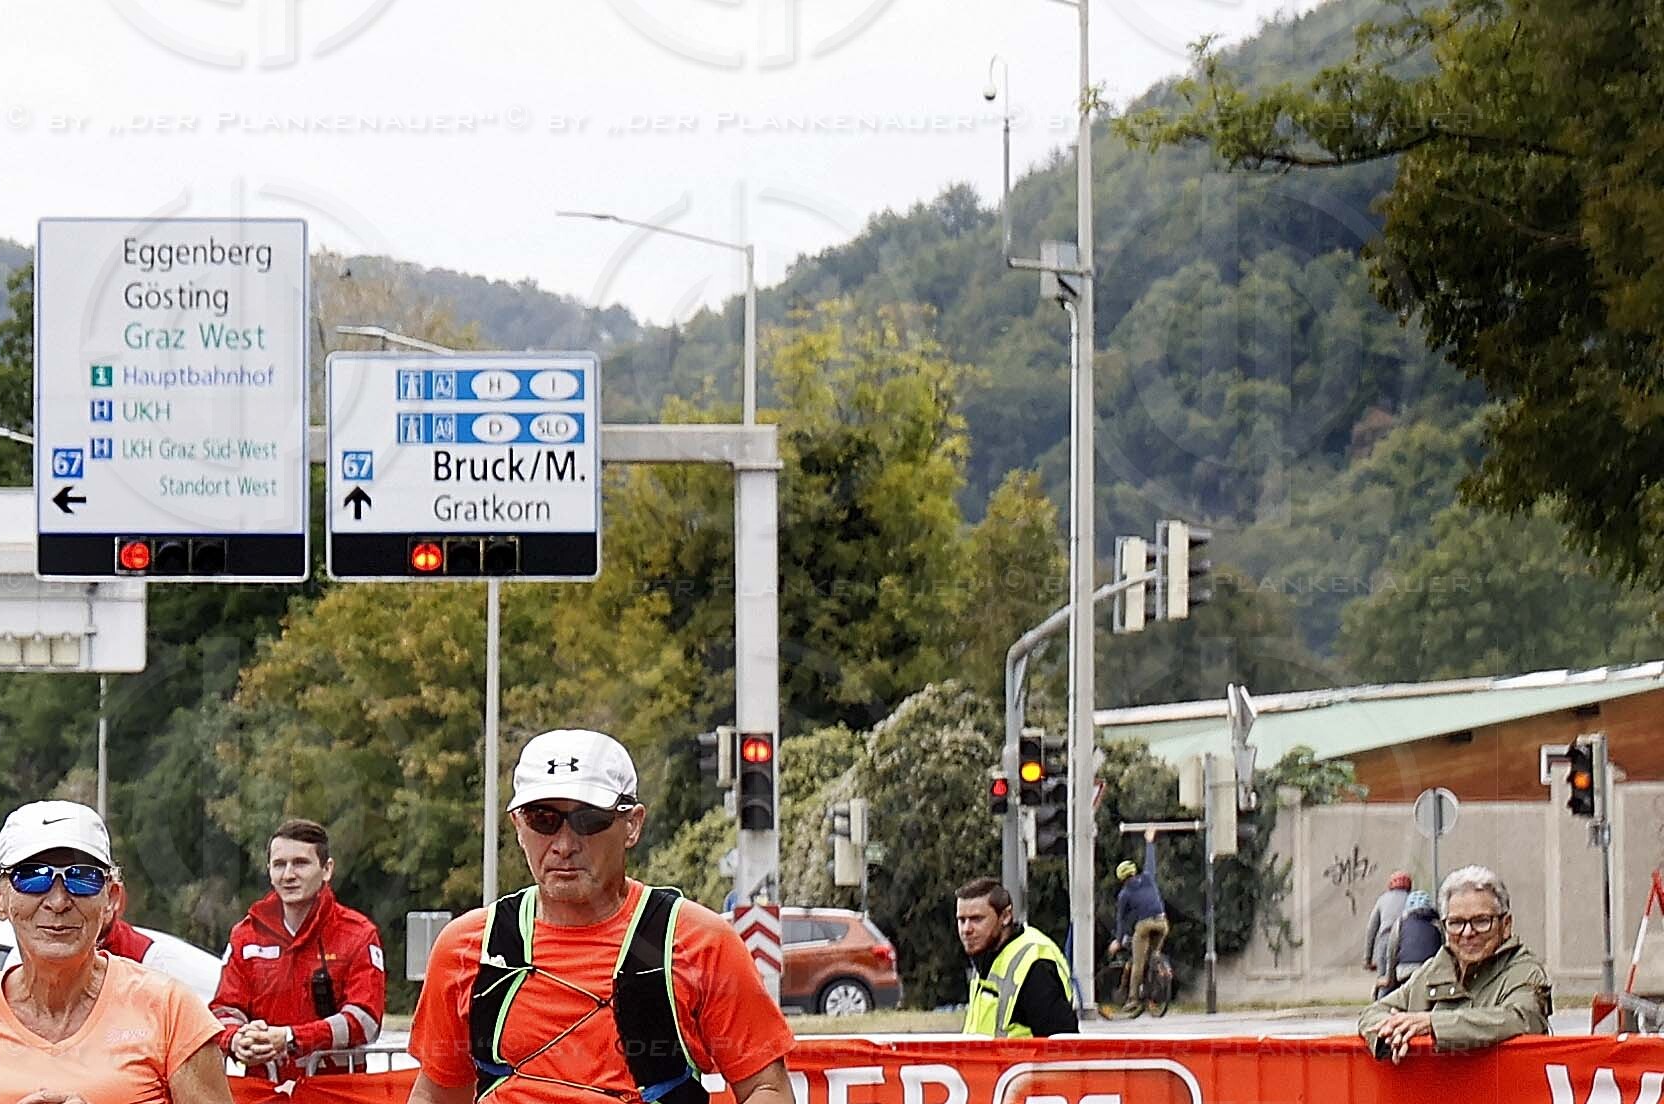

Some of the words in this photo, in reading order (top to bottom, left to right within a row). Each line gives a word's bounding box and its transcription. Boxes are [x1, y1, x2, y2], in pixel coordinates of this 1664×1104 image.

[123, 235, 272, 273] Eggenberg
[123, 280, 229, 317] Gösting
[124, 321, 186, 351] Graz
[199, 322, 266, 351] West
[123, 365, 274, 389] Hauptbahnhof
[122, 402, 171, 422] UKH
[489, 421, 502, 436] D
[537, 420, 569, 436] SLO
[122, 438, 152, 459] LKH
[159, 438, 195, 459] Graz
[202, 436, 278, 459] Süd-West
[53, 450, 83, 477] 67
[343, 452, 373, 479] 67
[434, 446, 587, 483] Bruck/M.
[159, 474, 231, 497] Standort
[237, 476, 278, 497] West
[434, 493, 551, 522] Gratkorn
